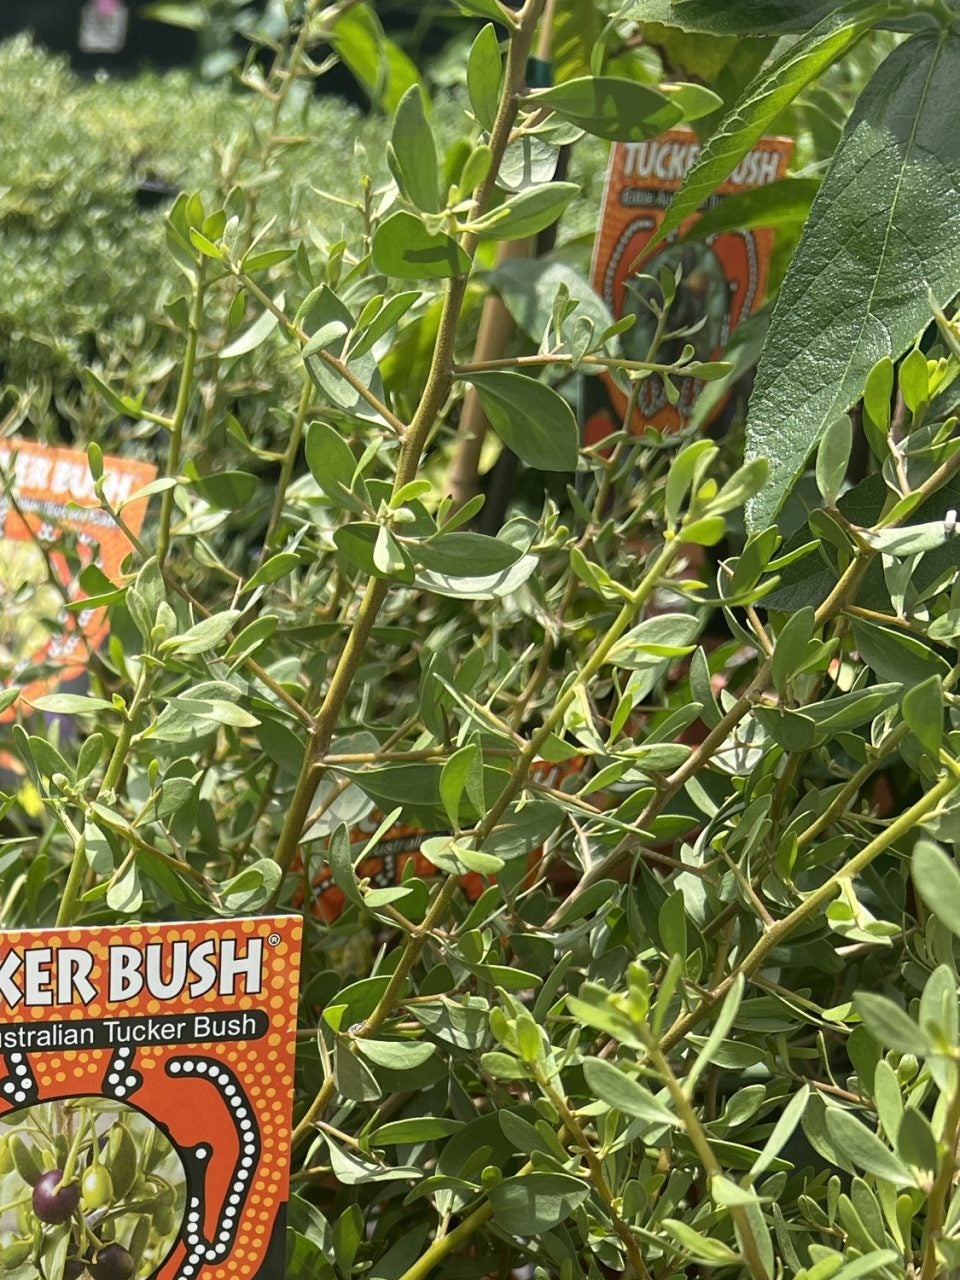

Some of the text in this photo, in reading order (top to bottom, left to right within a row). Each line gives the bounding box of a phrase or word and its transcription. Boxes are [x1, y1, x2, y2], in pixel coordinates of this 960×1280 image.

[730, 150, 780, 187] USH
[103, 1017, 186, 1044] Tucker
[194, 1013, 257, 1038] Bush
